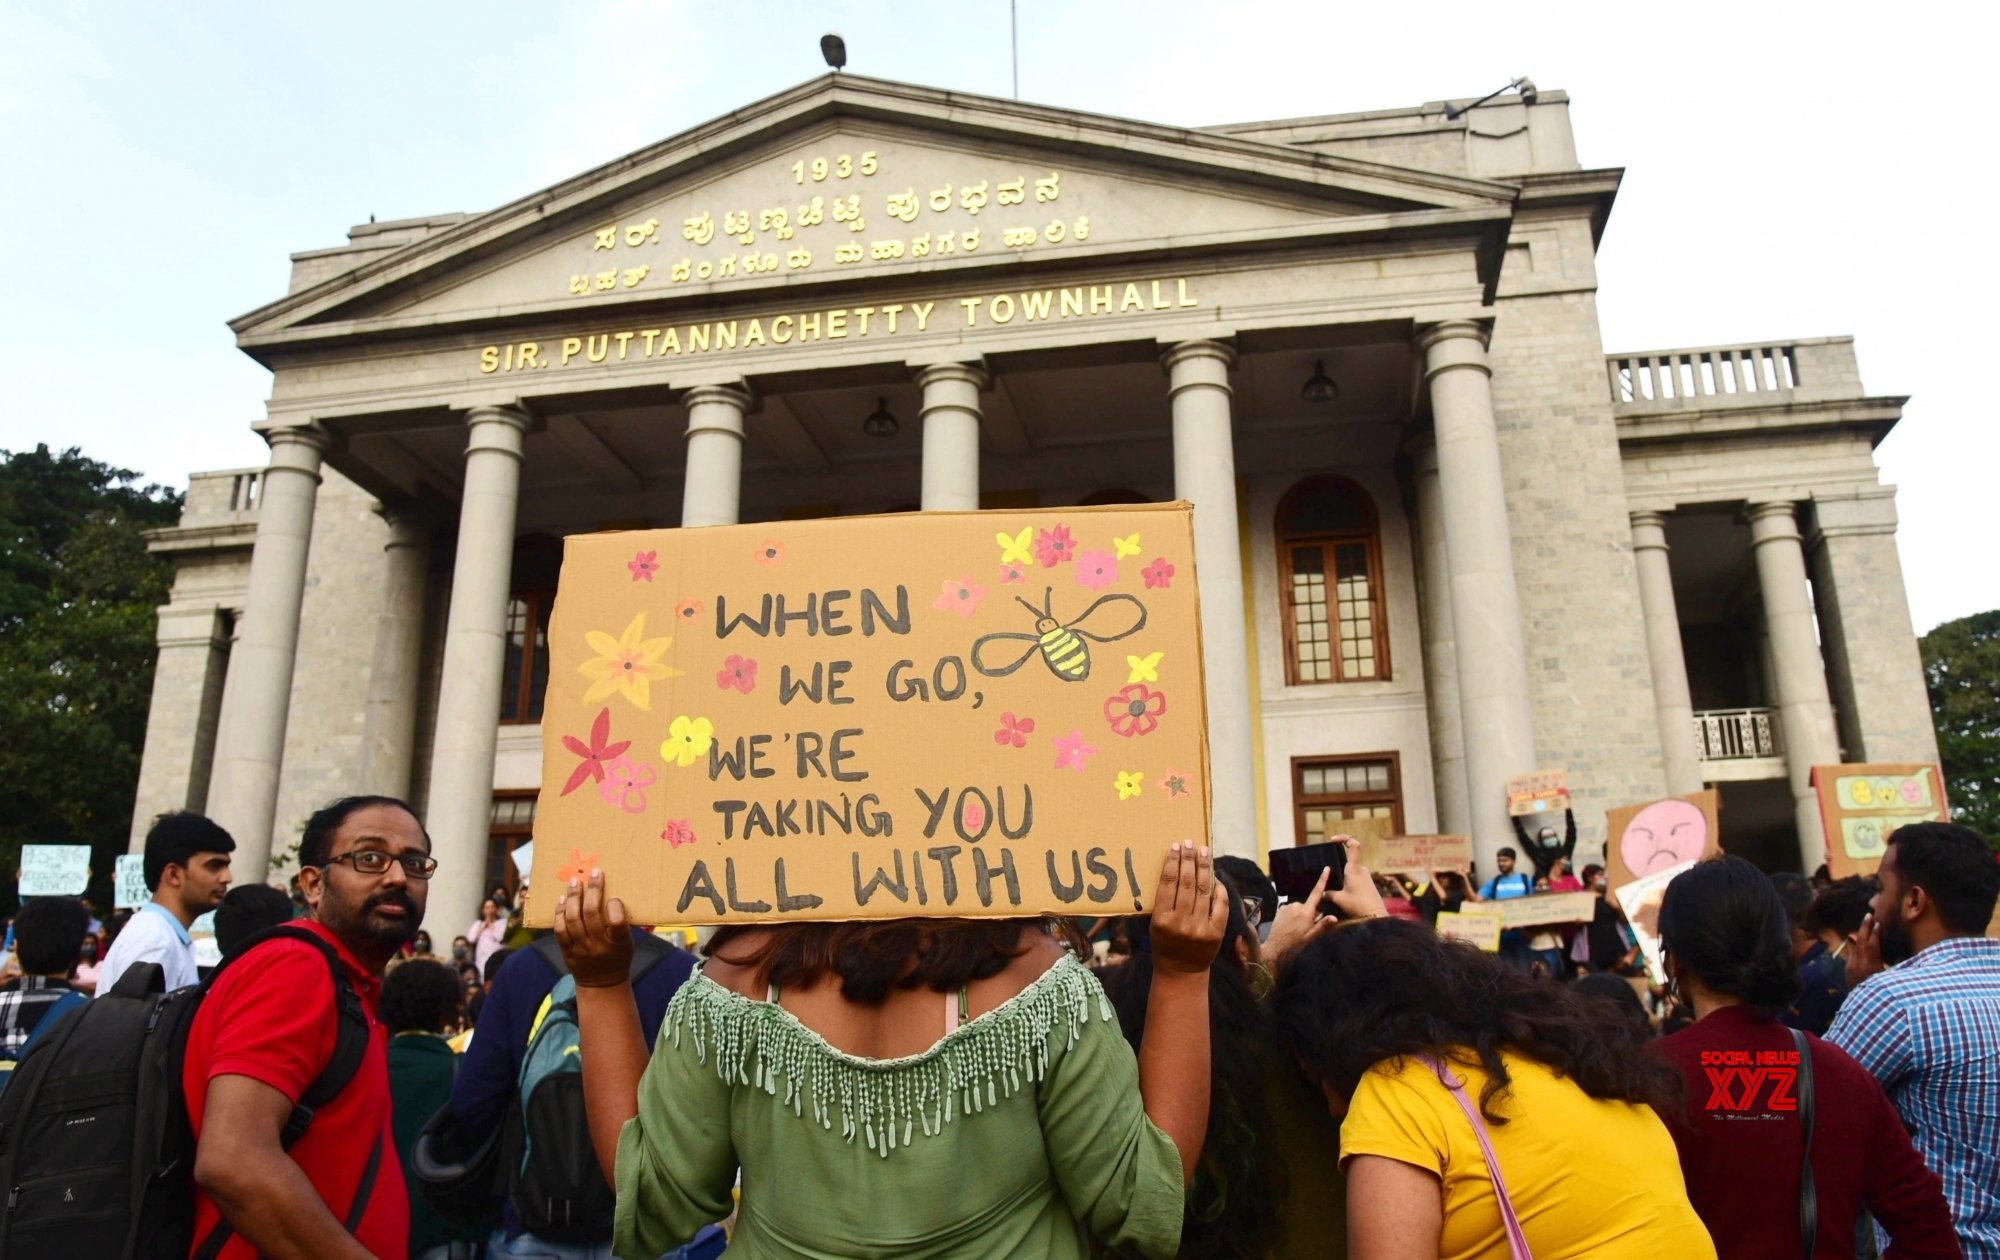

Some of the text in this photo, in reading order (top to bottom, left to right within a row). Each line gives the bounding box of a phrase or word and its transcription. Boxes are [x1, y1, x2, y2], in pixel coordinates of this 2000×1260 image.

[792, 151, 878, 184] 1935
[886, 172, 1060, 222] ಪುರಭವನ
[834, 226, 981, 264] ಮಹಾನಗರ
[1003, 215, 1091, 247] ಪಾಲಿಕೆ
[480, 278, 1199, 374] SIR. PUTTANNACHETTY TOWNHALL
[713, 585, 912, 639] WHEN
[779, 655, 985, 710] WE GO,
[708, 727, 870, 782] WE'RE
[713, 783, 1034, 844] TAKING YOU
[676, 845, 1144, 915] ALL WITH US!
